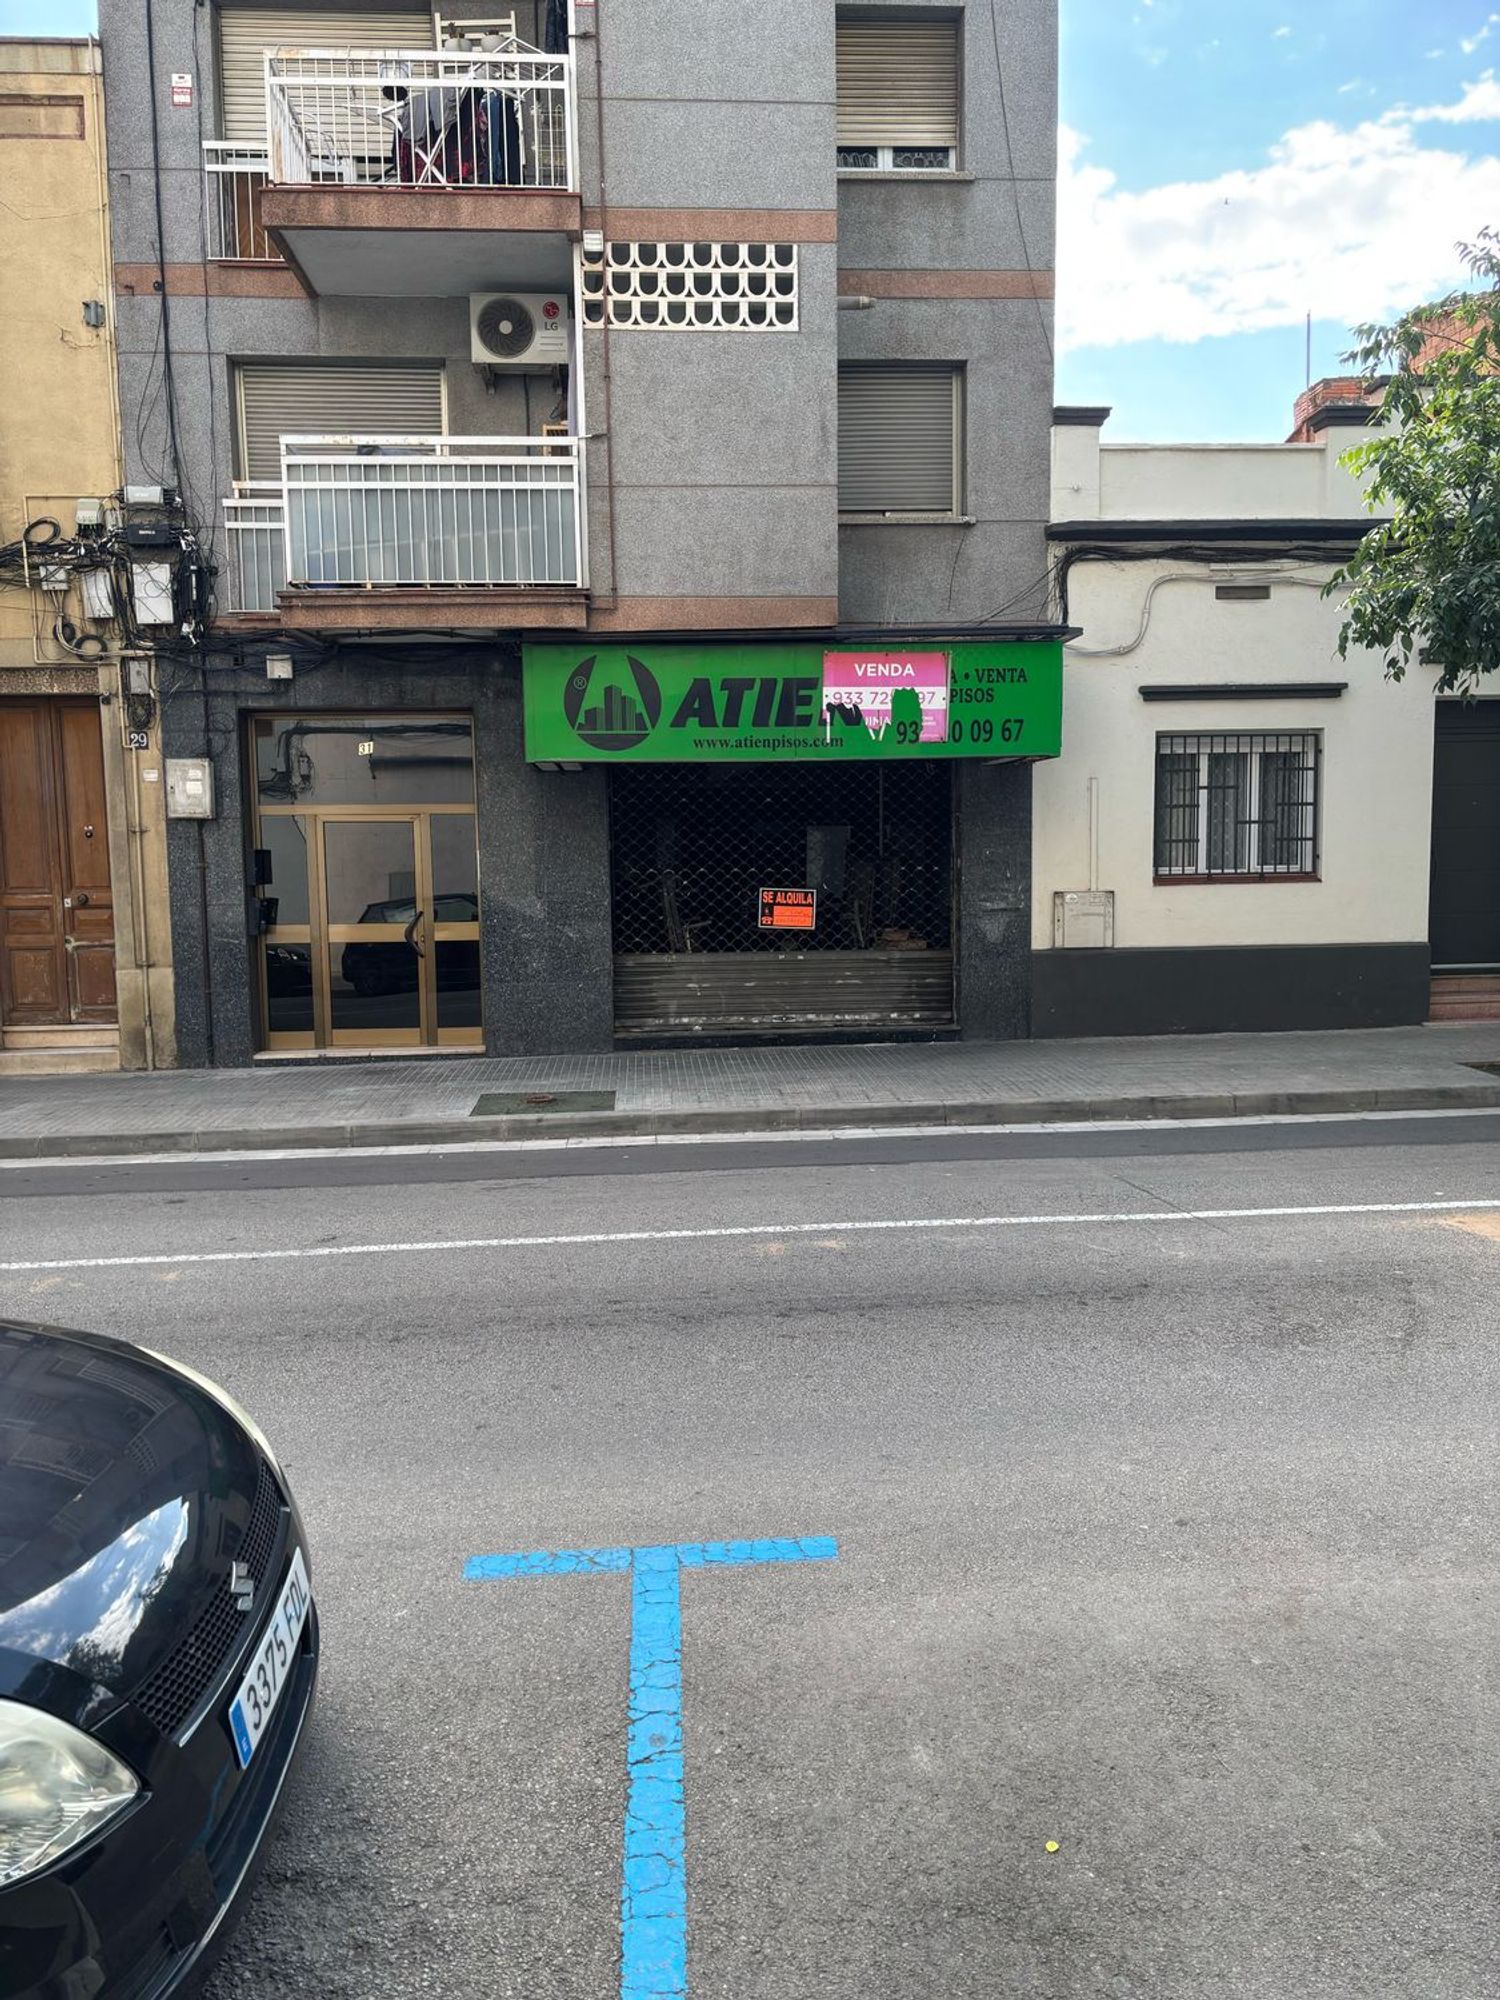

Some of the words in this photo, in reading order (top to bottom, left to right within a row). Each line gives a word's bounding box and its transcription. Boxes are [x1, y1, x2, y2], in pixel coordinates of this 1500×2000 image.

[544, 321, 559, 331] LG
[854, 663, 915, 677] VENDA
[974, 668, 1028, 684] VENTA
[833, 691, 863, 705] 933
[869, 691, 892, 705] 72
[949, 688, 994, 704] PISOS
[896, 721, 919, 744] 93
[970, 719, 993, 743] 09
[1001, 718, 1024, 742] 67
[130, 733, 147, 747] 29
[693, 735, 844, 751] www.atienpisos.com
[359, 743, 372, 755] 31
[762, 890, 774, 904] SE
[775, 891, 813, 905] ALQUILA
[247, 1622, 287, 1731] 3375
[282, 1570, 308, 1643] FDL
